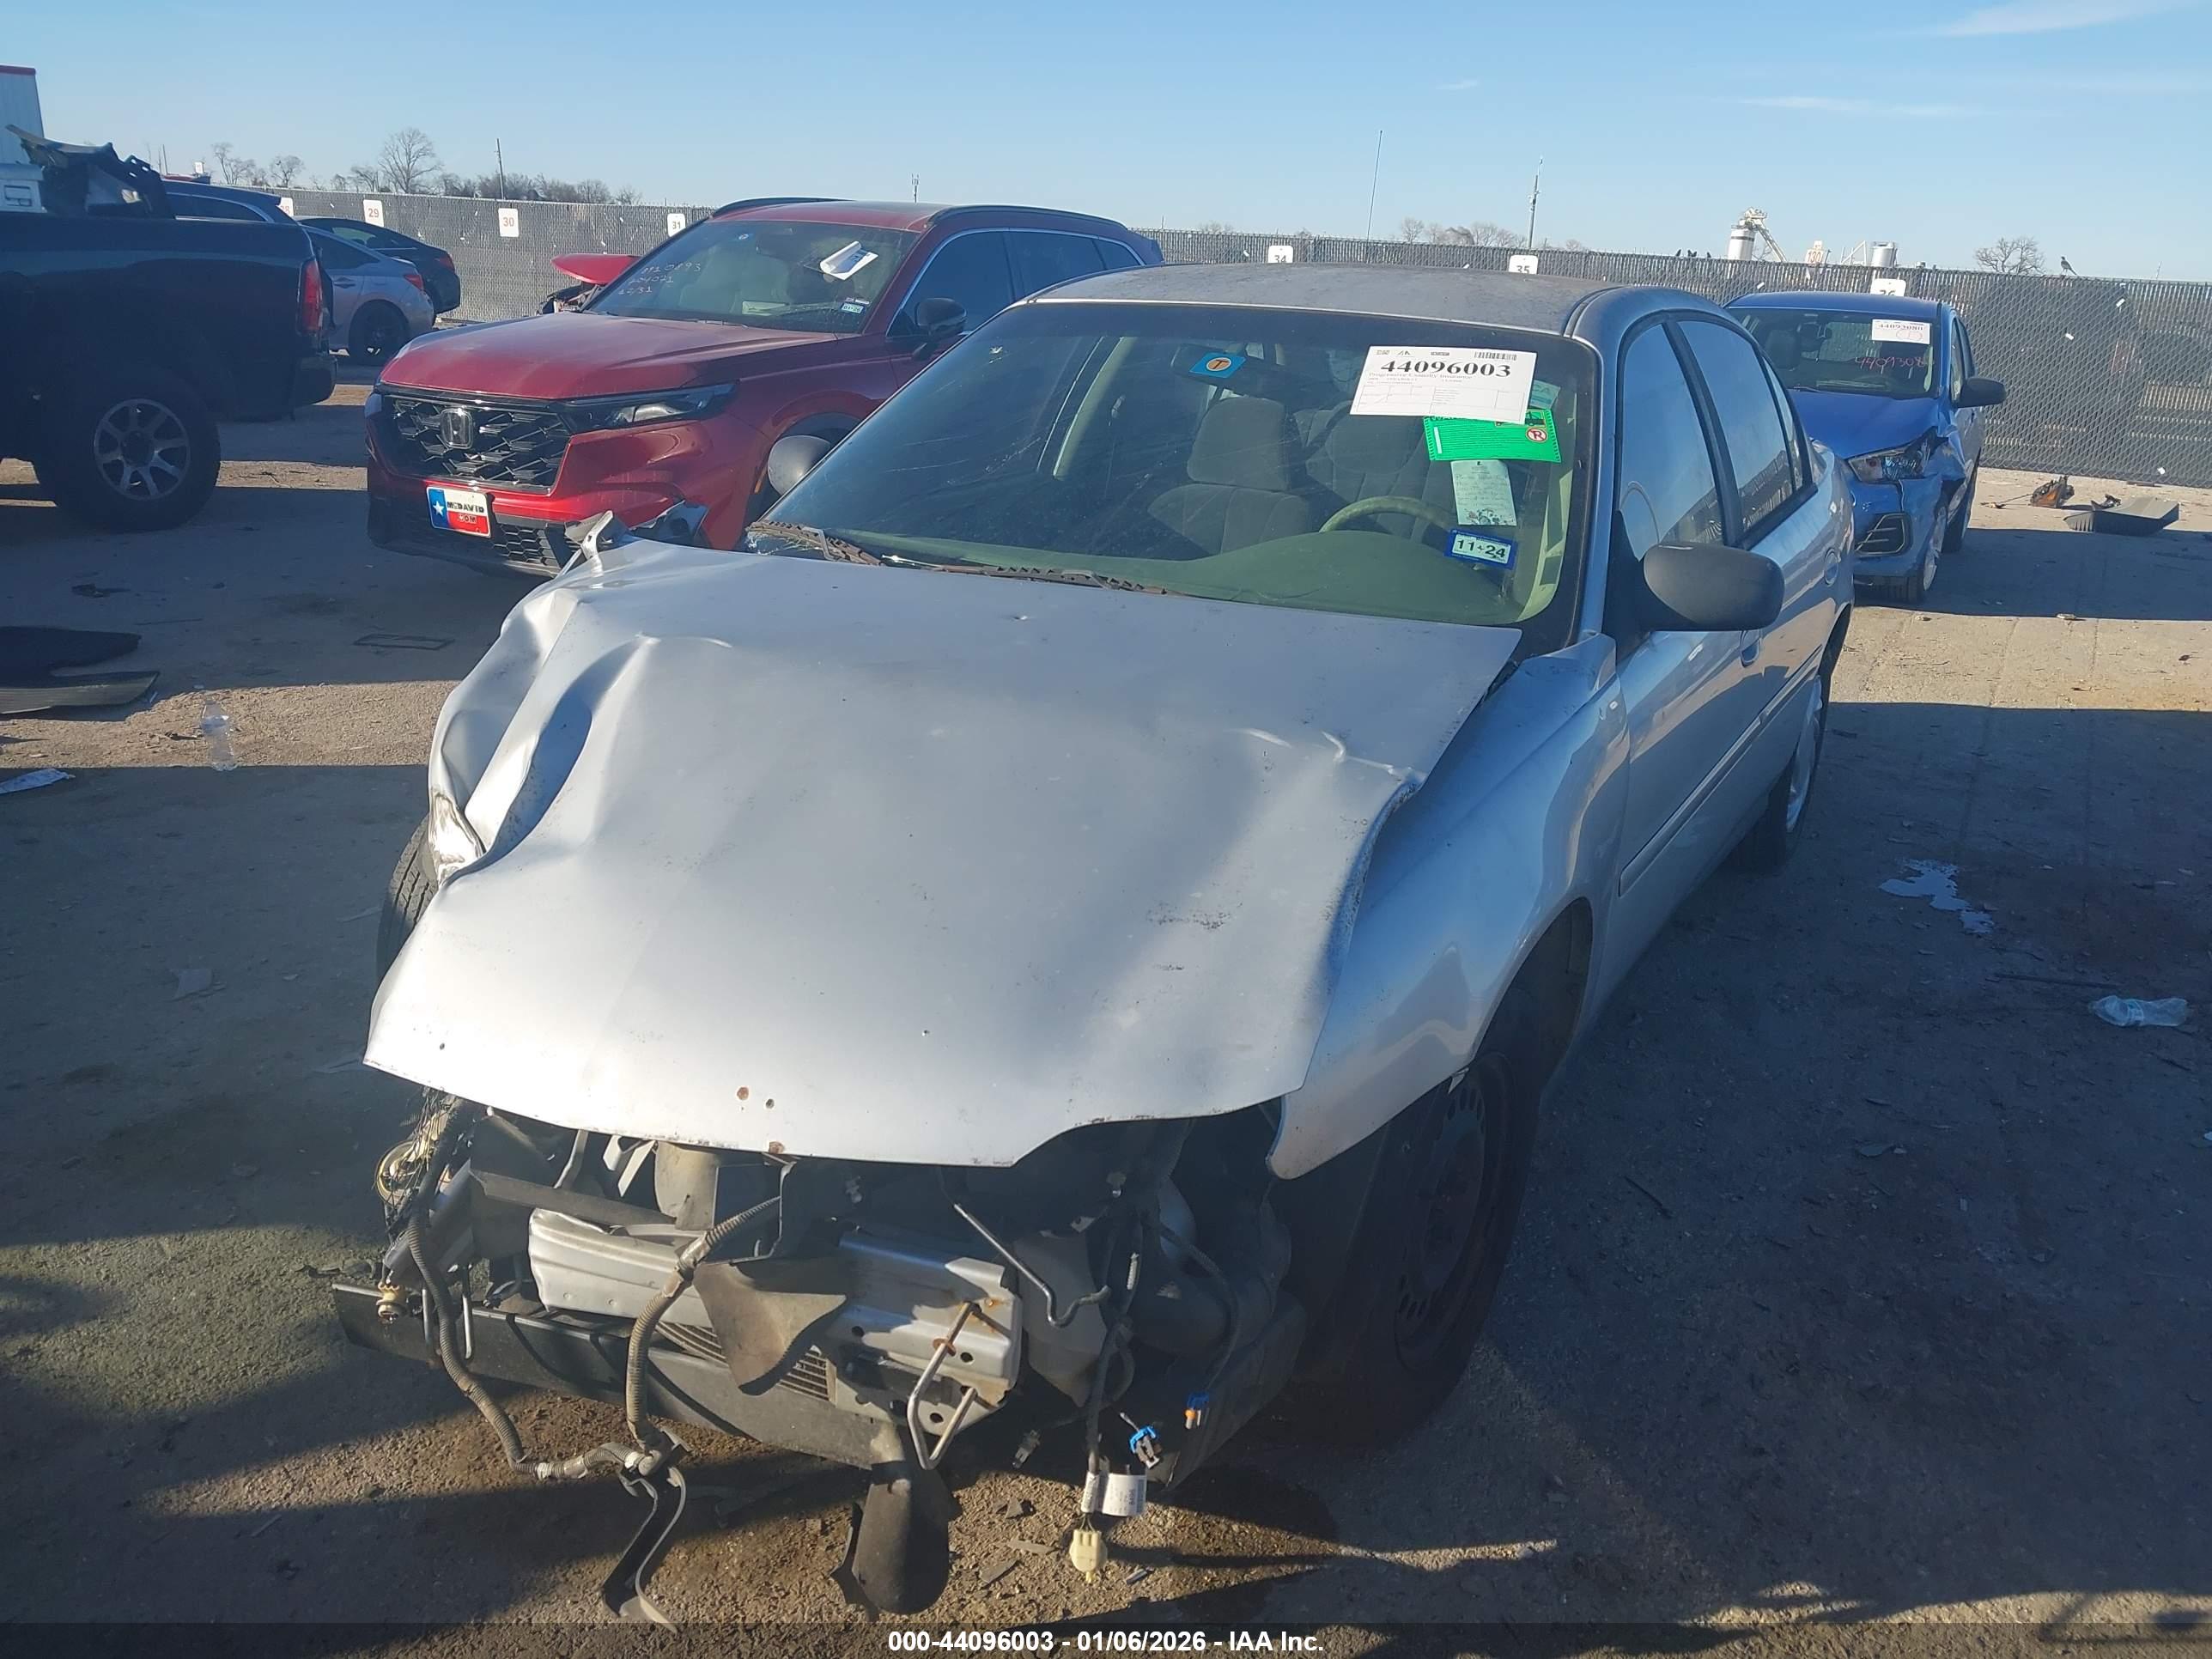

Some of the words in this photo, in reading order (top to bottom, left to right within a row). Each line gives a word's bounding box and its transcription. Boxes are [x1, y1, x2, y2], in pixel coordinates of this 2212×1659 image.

[368, 208, 380, 218] 29
[502, 216, 514, 228] 30
[672, 221, 681, 230] 31
[1381, 361, 1511, 378] 44096003
